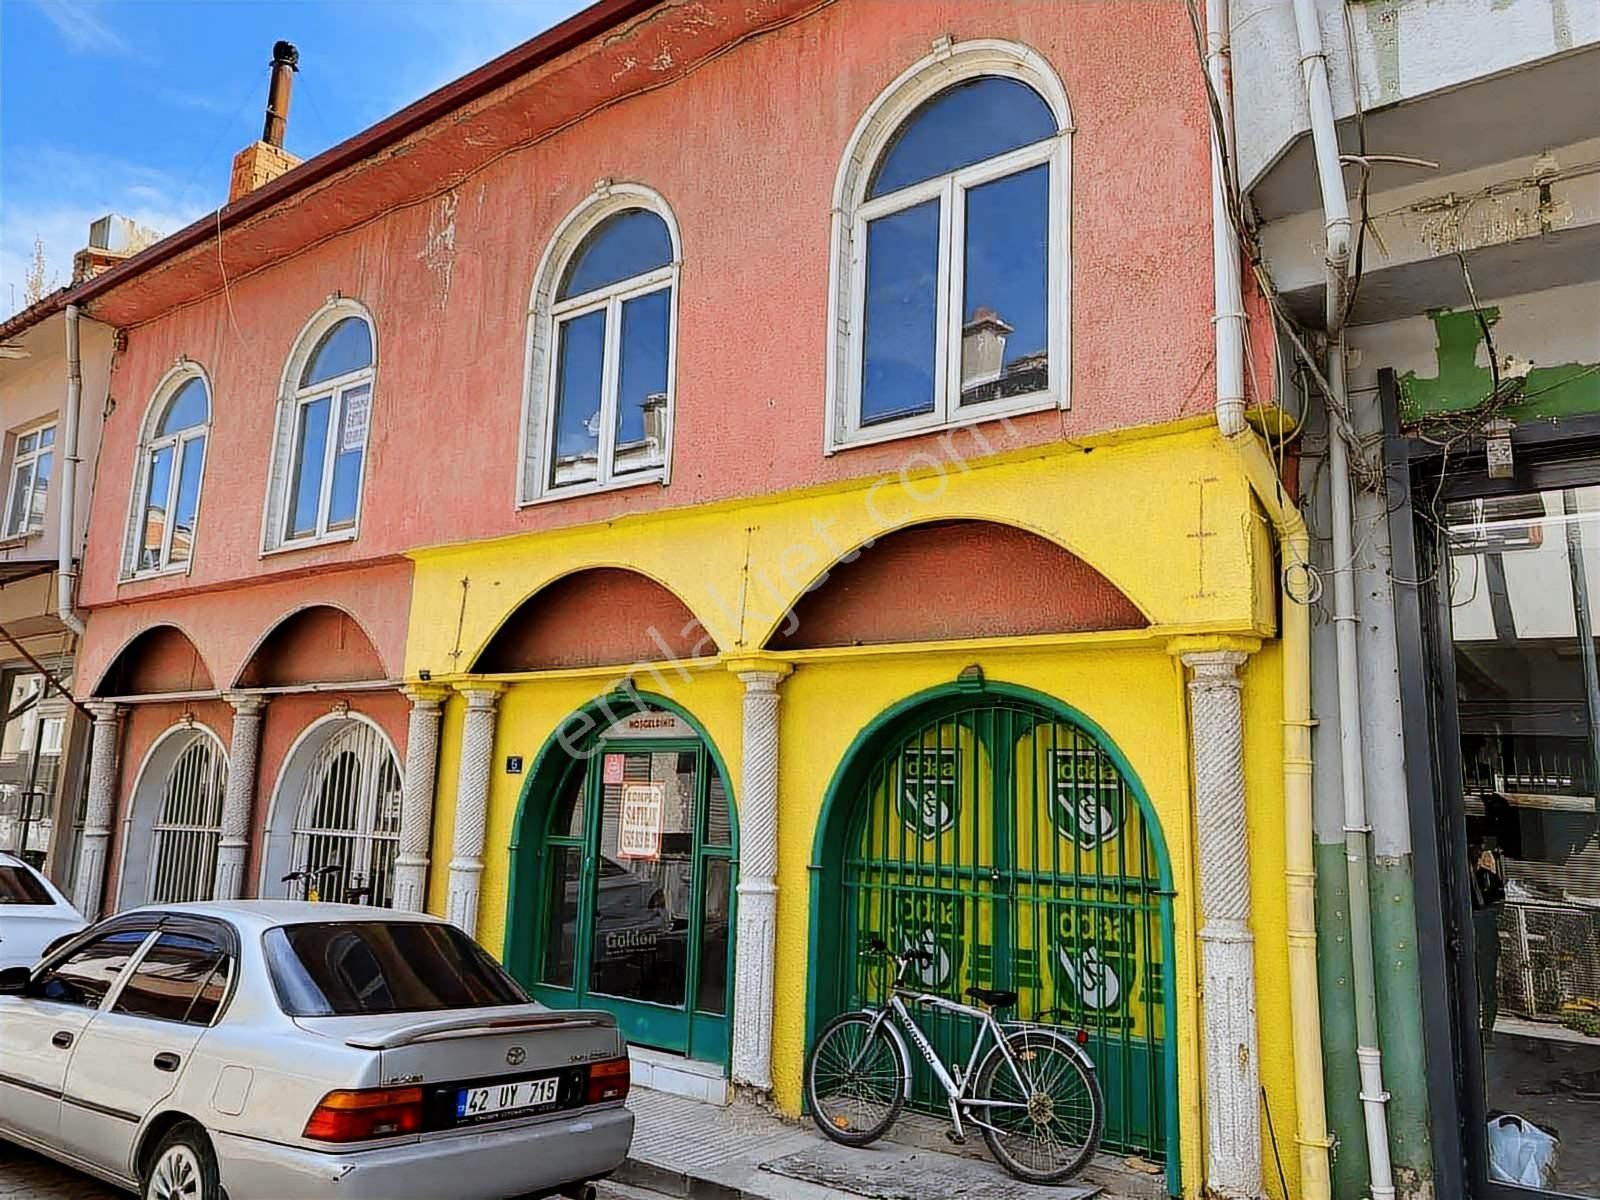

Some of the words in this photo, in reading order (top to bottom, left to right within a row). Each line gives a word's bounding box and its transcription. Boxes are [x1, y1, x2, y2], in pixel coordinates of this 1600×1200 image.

[468, 1089, 489, 1113] 42
[499, 1084, 519, 1108] UY
[529, 1079, 557, 1103] 715
